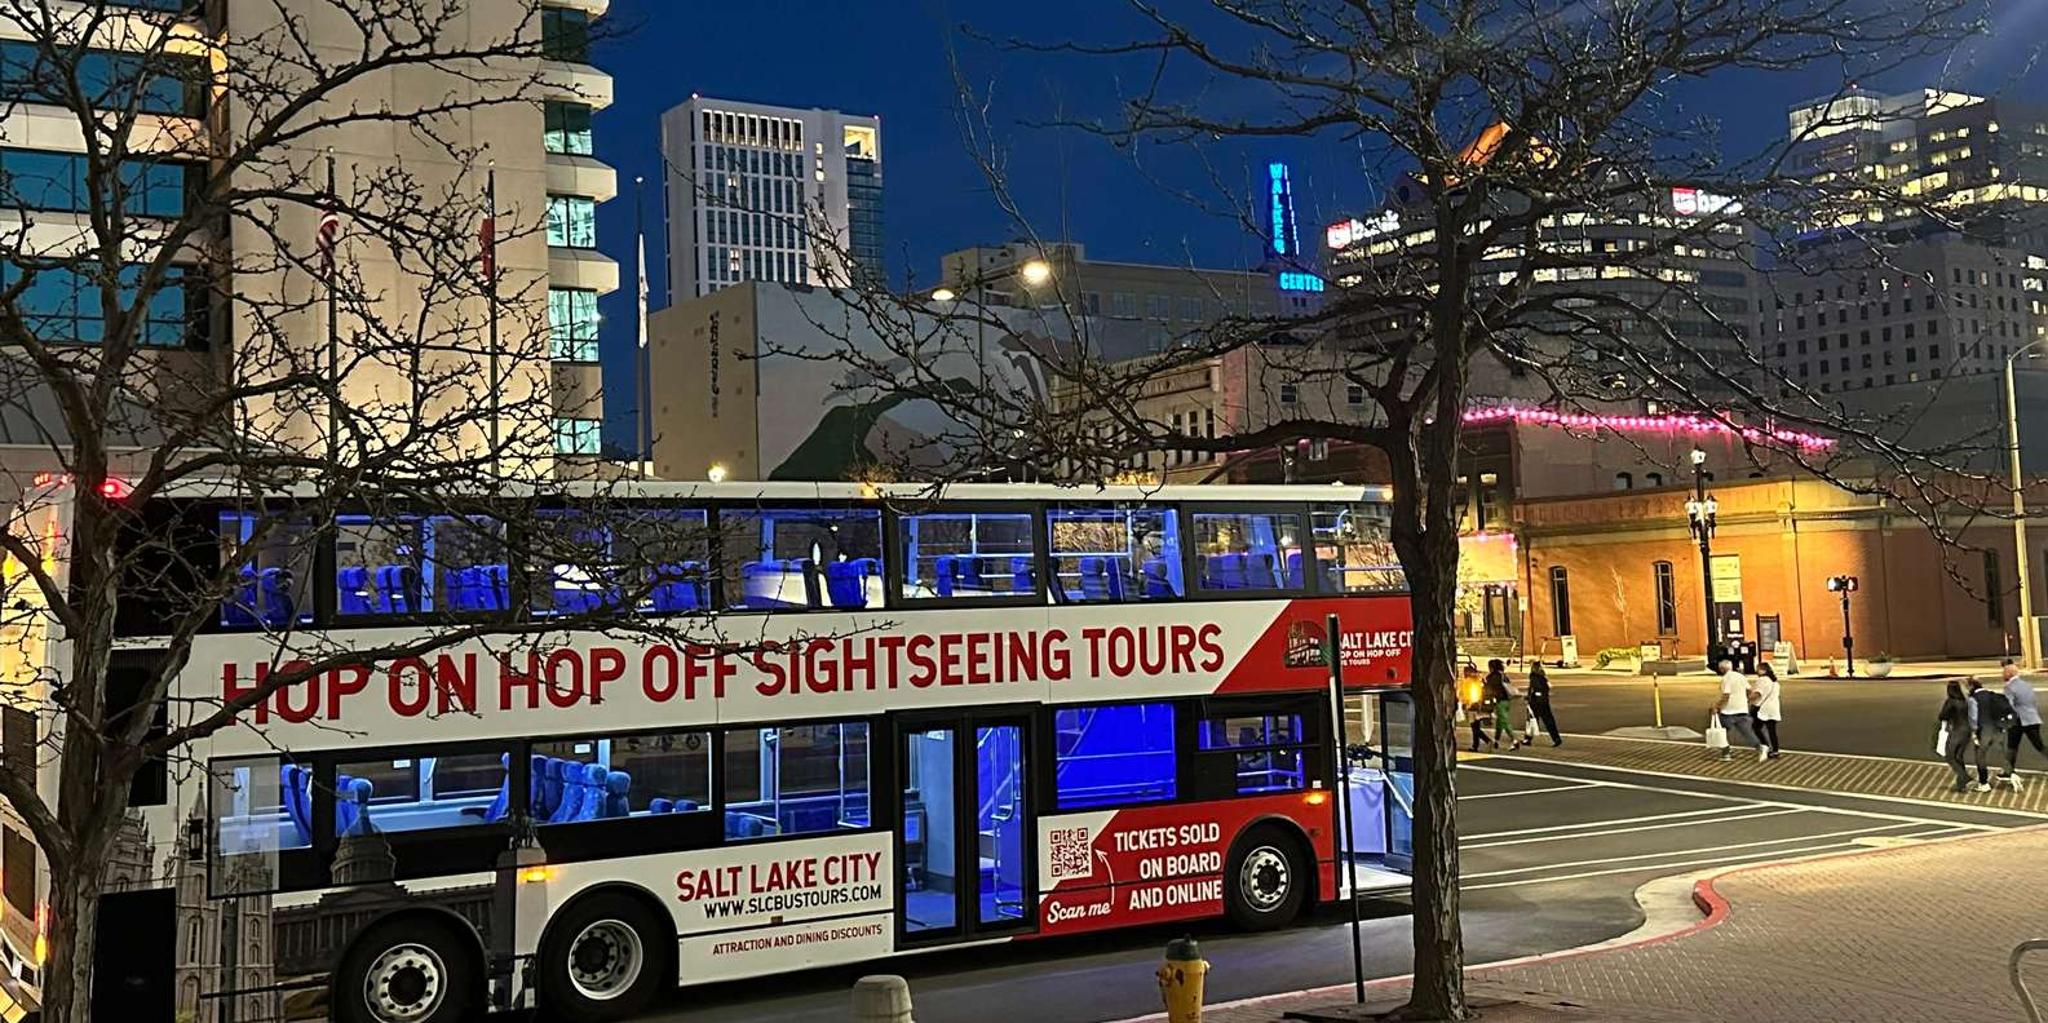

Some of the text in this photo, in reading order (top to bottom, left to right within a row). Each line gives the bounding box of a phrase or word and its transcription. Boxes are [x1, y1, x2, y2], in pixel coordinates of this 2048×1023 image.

[1269, 163, 1285, 254] WALKER
[1339, 630, 1414, 649] ALT LAKE CI
[1340, 650, 1352, 659] OP
[1366, 649, 1384, 658] HOP
[1385, 648, 1401, 657] OFF
[223, 623, 1223, 726] HOP ON HOP OFF SIGHTSEEING TOURS
[1114, 823, 1220, 852] TICKETS SOLD
[676, 851, 882, 902] SALT LAKE CITY
[1140, 852, 1221, 880] ON BOARD
[704, 884, 882, 919] WWW.SLCBUSTOURS.COM
[1129, 879, 1222, 910] AND ONLINE
[1047, 900, 1112, 924] Scan me
[712, 923, 883, 956] ATTRACTION AND DINING DISCOUNTS
